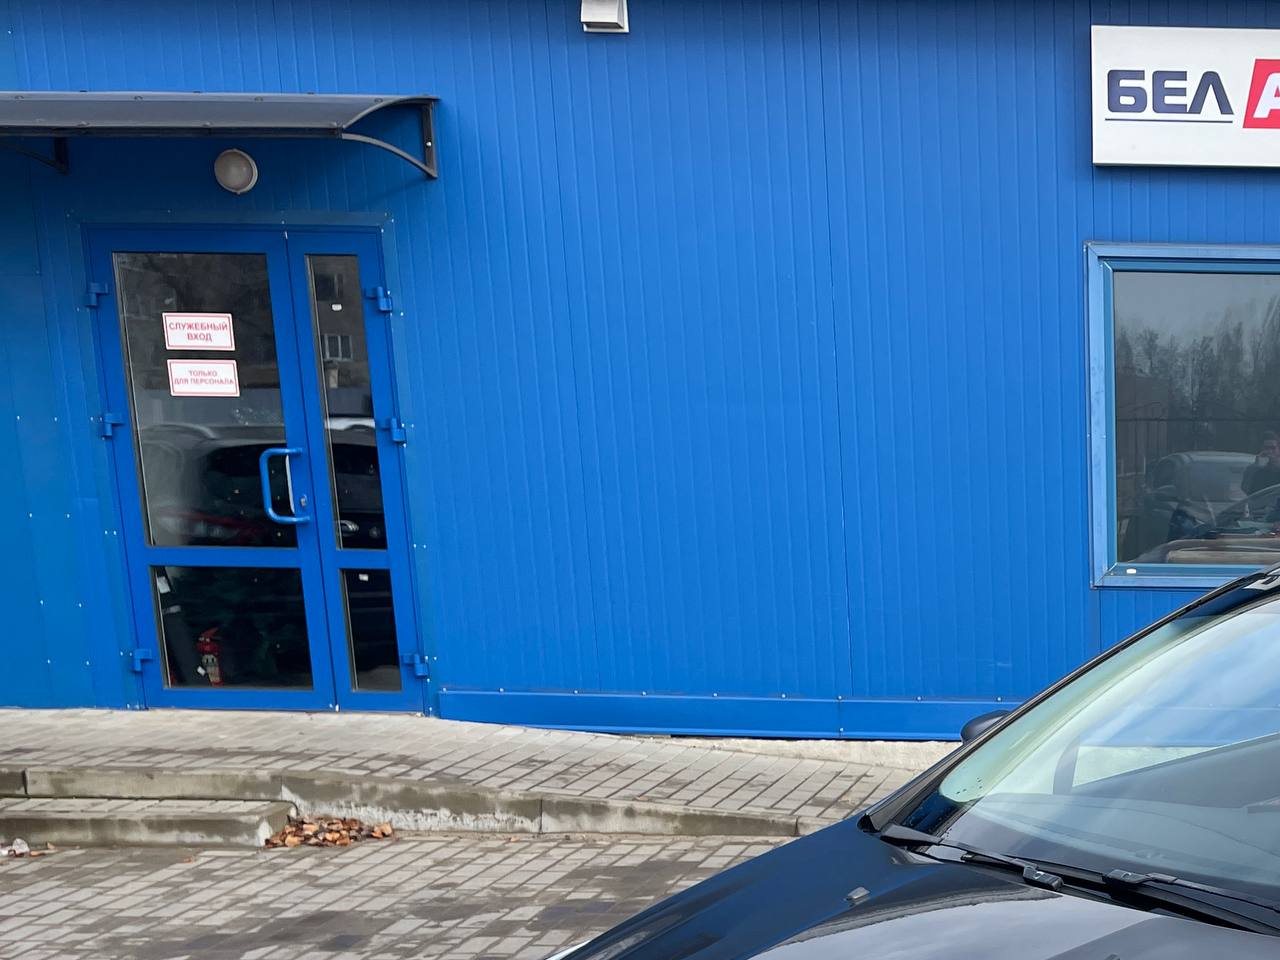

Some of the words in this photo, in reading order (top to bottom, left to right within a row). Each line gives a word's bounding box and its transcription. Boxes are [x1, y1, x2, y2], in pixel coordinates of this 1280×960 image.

[1107, 69, 1234, 115] БЕЛ
[169, 321, 229, 331] СЛУЖЕБНЫЙ
[187, 332, 212, 342] ВХОД
[188, 369, 218, 377] ТОЛЬКО
